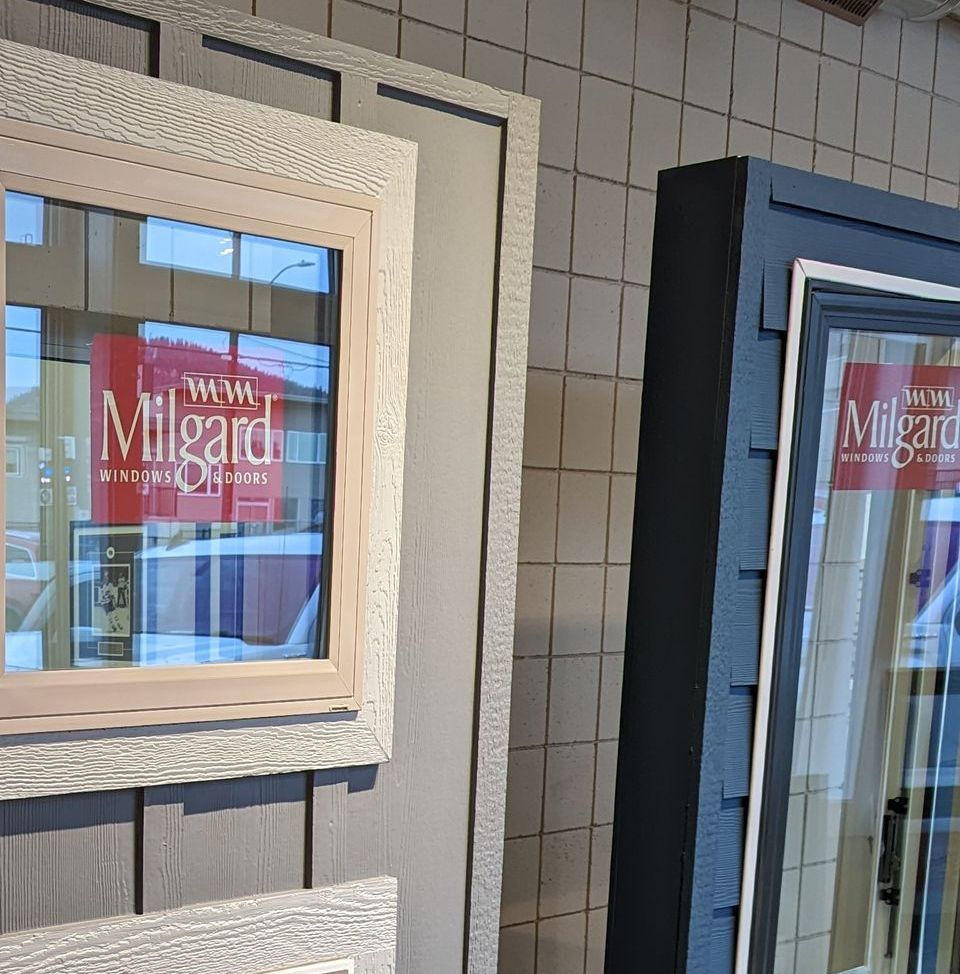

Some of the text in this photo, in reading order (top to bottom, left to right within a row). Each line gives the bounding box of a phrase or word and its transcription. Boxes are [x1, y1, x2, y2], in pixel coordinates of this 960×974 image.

[100, 388, 272, 493] Milgard
[841, 396, 960, 469] Milgard
[99, 469, 172, 483] WINDOWS
[840, 453, 889, 463] WINDOWS
